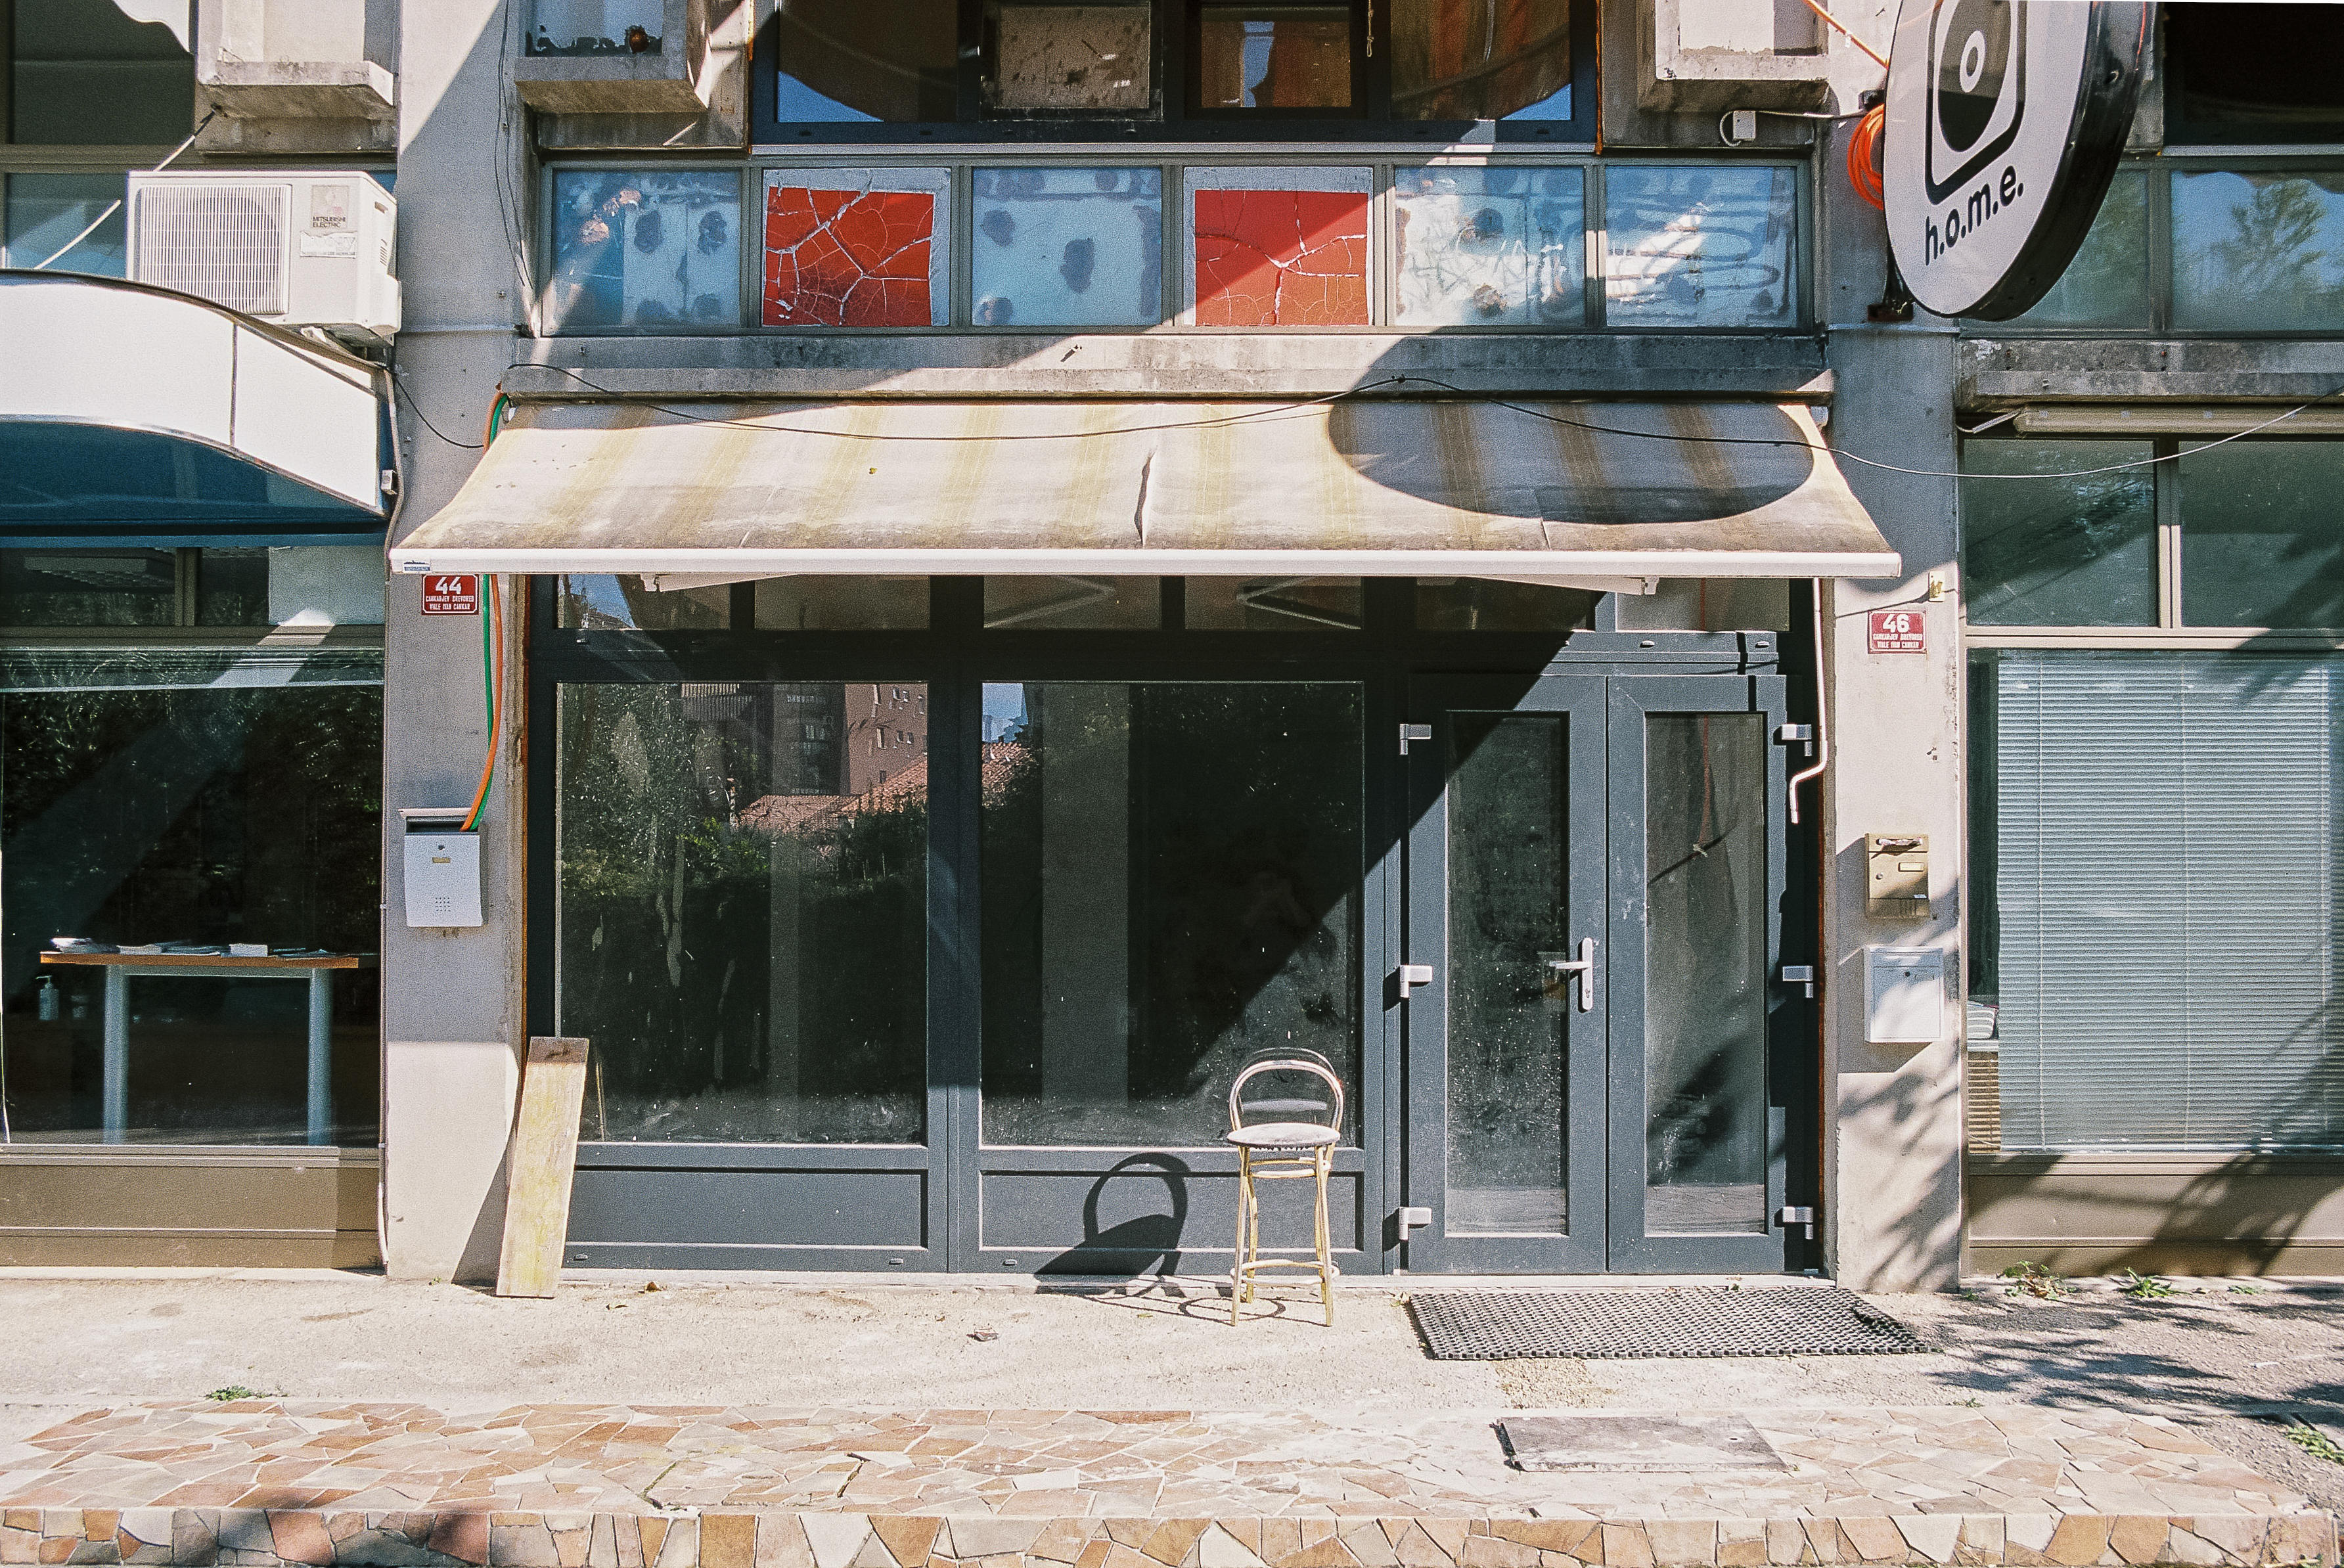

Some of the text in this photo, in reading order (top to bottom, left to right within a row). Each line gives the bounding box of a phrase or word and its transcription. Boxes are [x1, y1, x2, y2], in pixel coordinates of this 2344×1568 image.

[1926, 166, 2024, 266] h.o.m.e.
[435, 576, 462, 594] 44
[1882, 614, 1910, 633] 46
